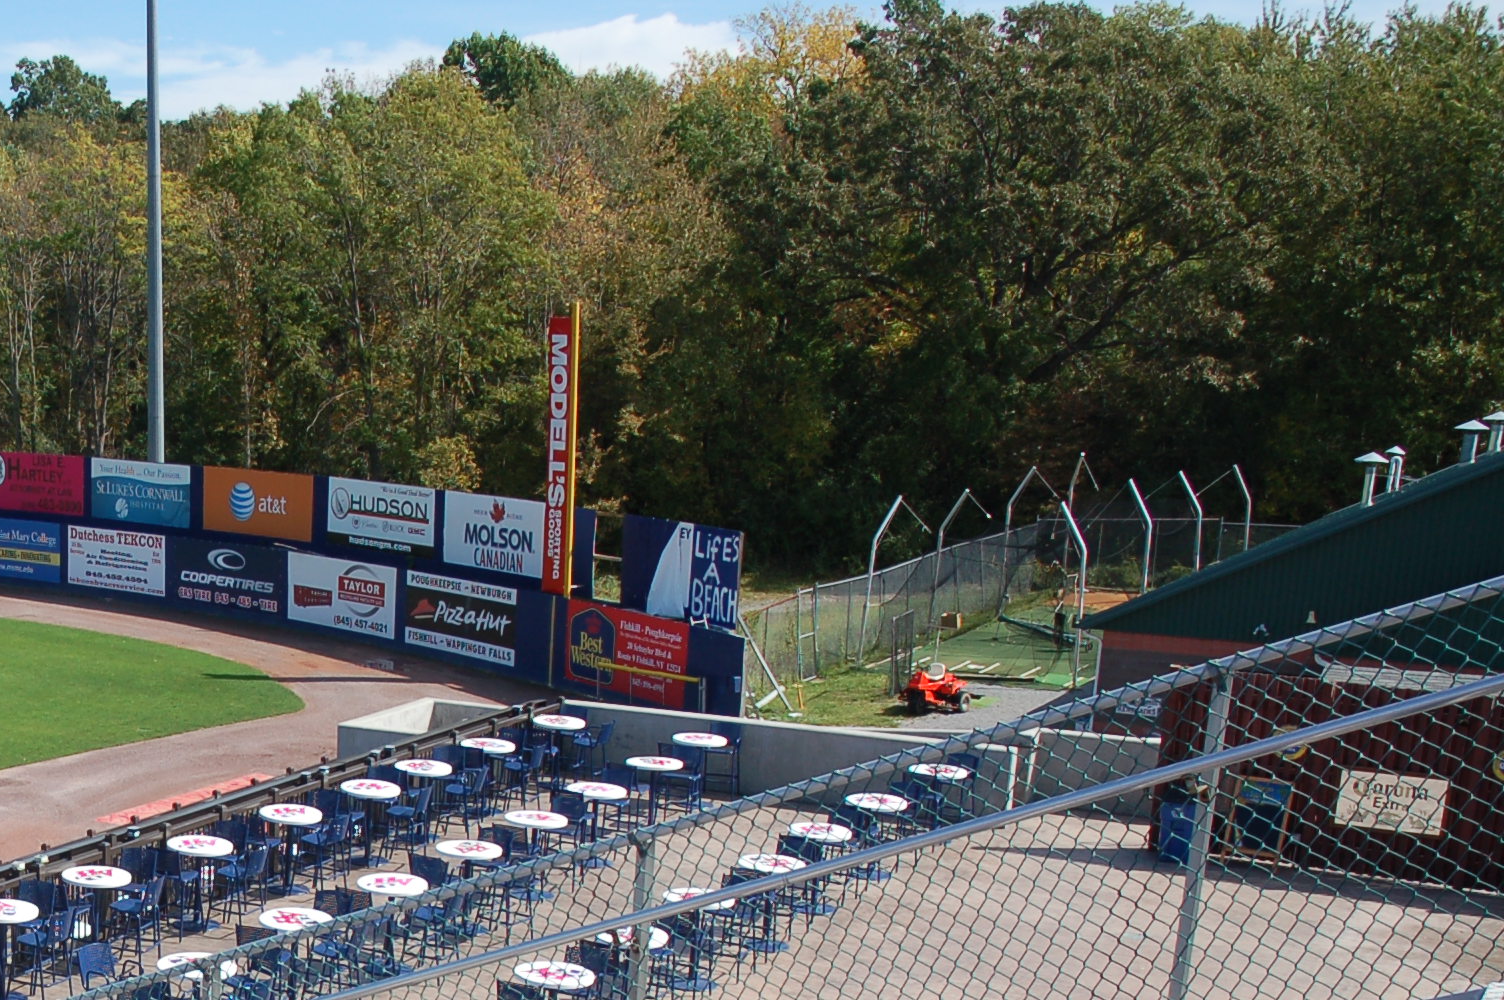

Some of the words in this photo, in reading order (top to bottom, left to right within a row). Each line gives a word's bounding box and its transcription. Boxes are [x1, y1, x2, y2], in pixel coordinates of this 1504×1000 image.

[548, 334, 568, 508] MODELL'S
[8, 457, 64, 483] HARTLEY
[99, 463, 113, 473] Your
[115, 465, 135, 476] Health
[144, 468, 155, 478] Our
[106, 482, 134, 497] LUKE'S
[135, 484, 186, 503] CORNWALL
[258, 494, 287, 515] at&t
[350, 493, 428, 520] HUDSON
[11, 529, 30, 544] Mary
[31, 531, 57, 547] College
[70, 527, 115, 544] Dutchess
[116, 533, 163, 549] TEKCON
[464, 522, 533, 554] MOLSON
[547, 508, 556, 557] GOODS
[552, 509, 562, 580] SPORTING
[474, 547, 523, 574] CANADIAN
[703, 562, 720, 585] A
[342, 579, 380, 596] TAYLOR
[410, 573, 462, 592] POUGHKEEPSIE
[470, 583, 512, 601] NEWBURGH
[691, 578, 738, 624] BEACH
[333, 614, 352, 628] (845)
[353, 617, 388, 634] 457-4021
[434, 600, 476, 626] Pizza
[475, 607, 511, 637] Hut
[408, 630, 438, 646] FISHKILL
[445, 638, 486, 656] WAPPINGER
[487, 645, 512, 662] FALLS
[579, 632, 604, 654] Best
[571, 645, 614, 672] Western
[1353, 777, 1429, 801] Corona
[1372, 796, 1409, 811] Extra
